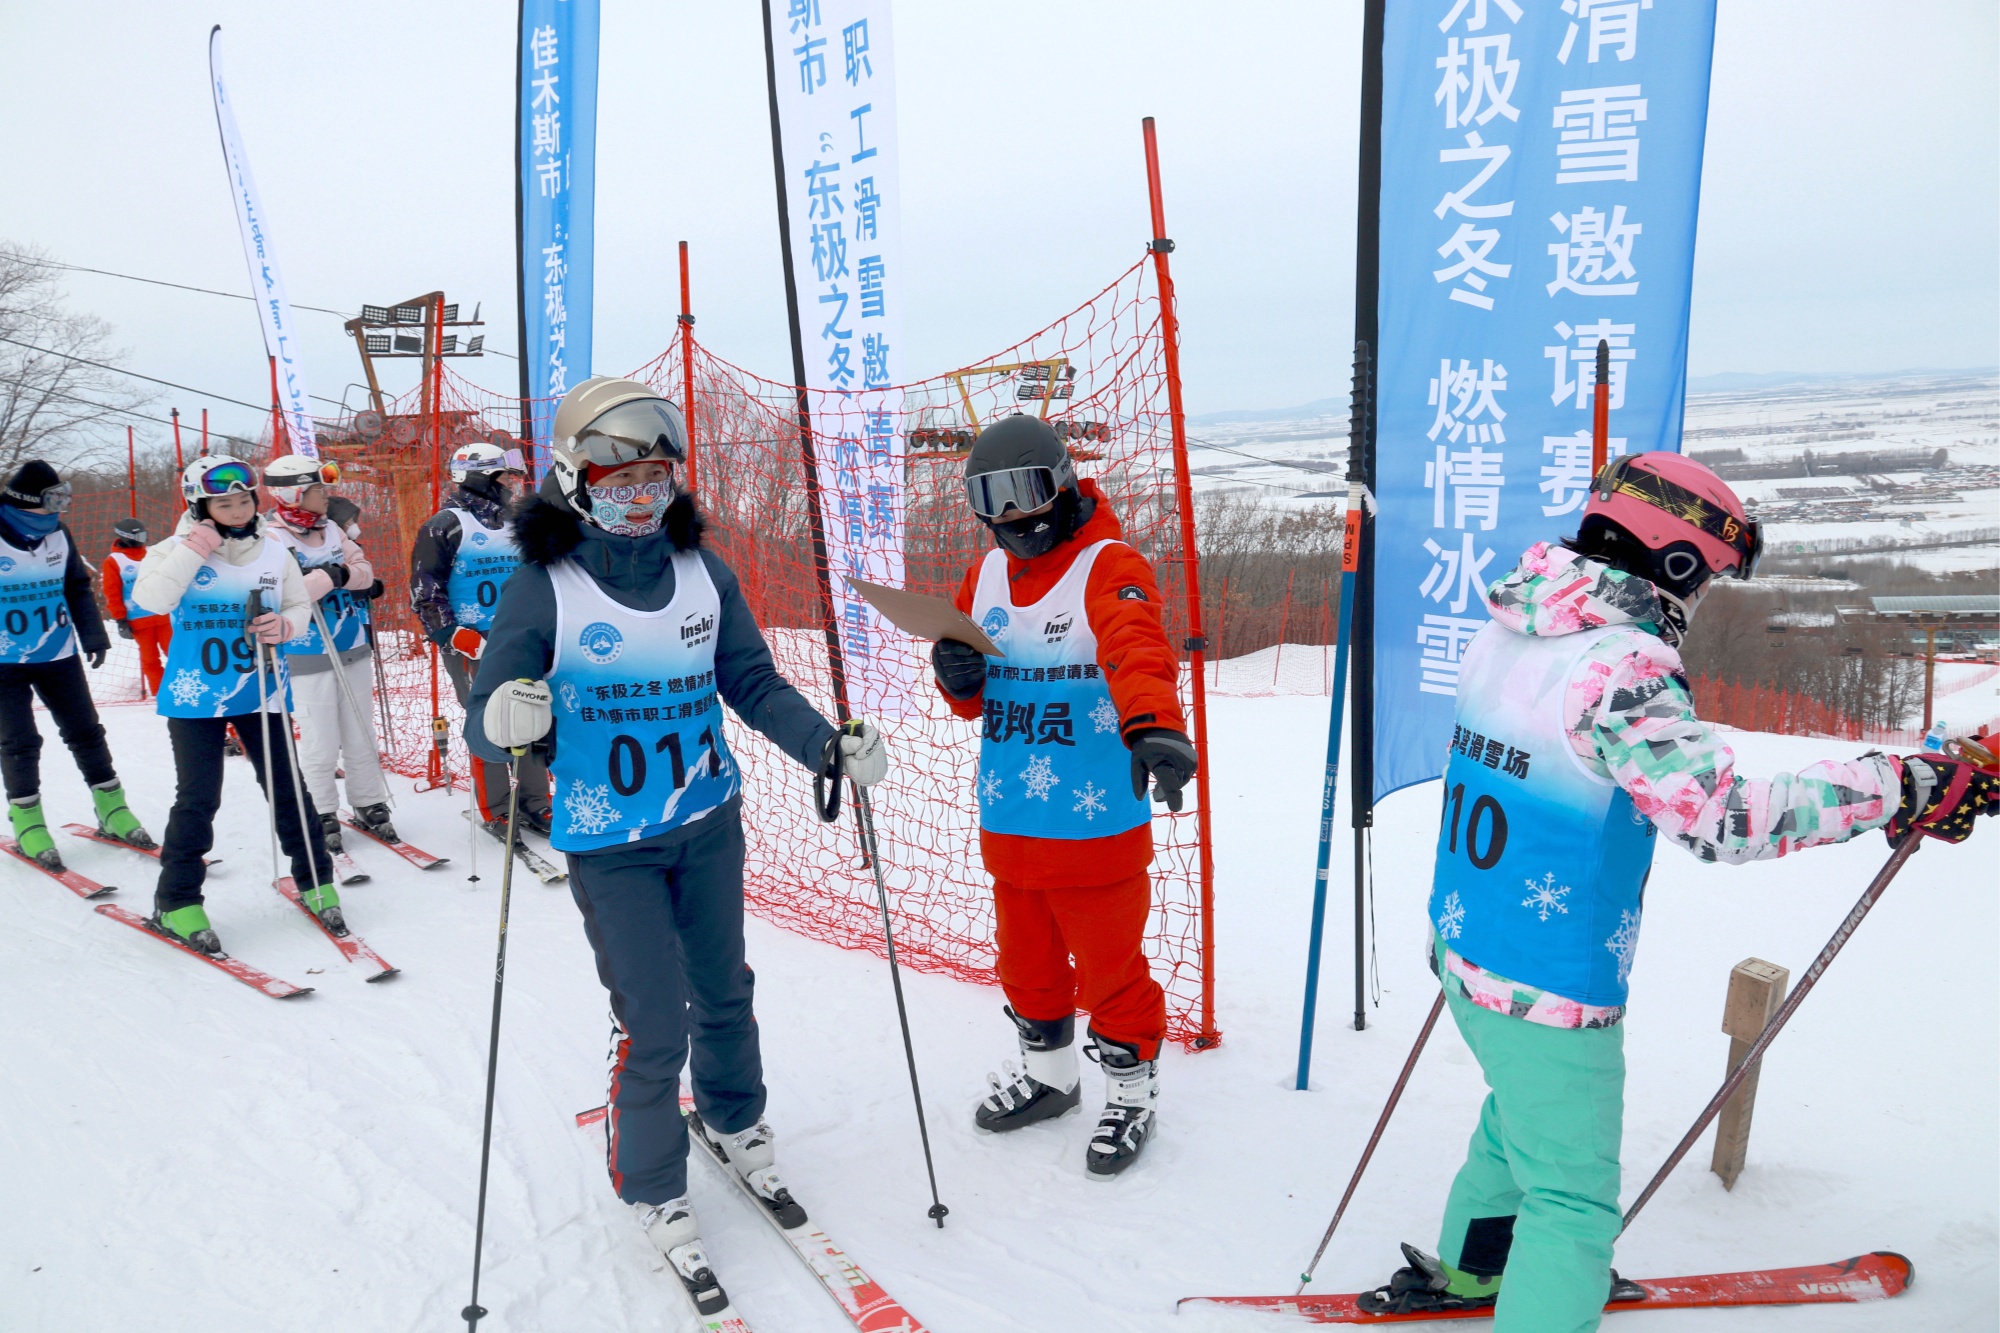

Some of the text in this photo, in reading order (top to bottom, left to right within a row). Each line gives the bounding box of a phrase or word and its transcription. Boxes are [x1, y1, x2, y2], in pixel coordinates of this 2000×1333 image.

[530, 25, 562, 199] 佳木斯市
[5, 602, 69, 636] 016
[680, 614, 714, 641] Inski
[201, 637, 262, 676] 09
[586, 679, 663, 702] “东极之冬
[608, 724, 720, 797] 011
[1441, 782, 1509, 871] 10
